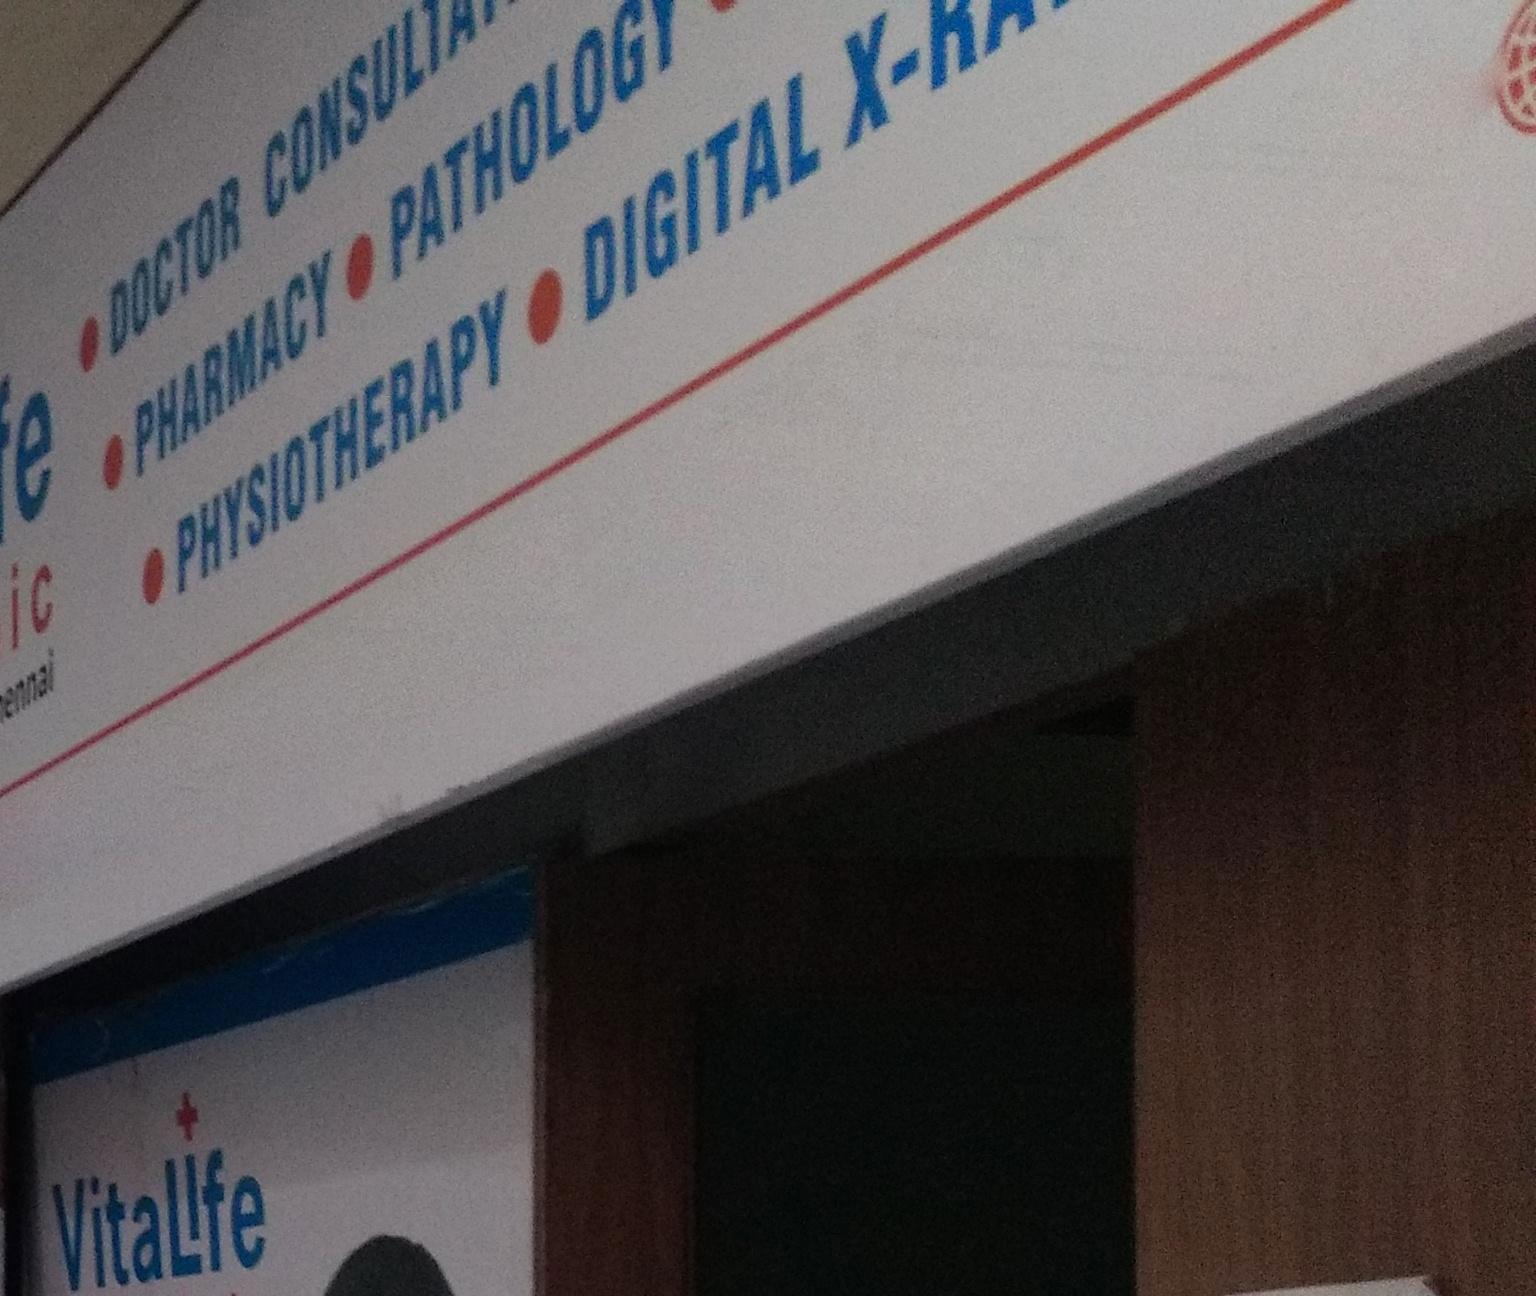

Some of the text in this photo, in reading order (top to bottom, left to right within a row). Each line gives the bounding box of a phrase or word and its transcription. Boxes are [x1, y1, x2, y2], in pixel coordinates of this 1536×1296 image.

[110, 0, 515, 355] DOCTOR CONSULTA
[135, 0, 676, 477] PHARMACY PATHOLOGY
[176, 288, 507, 594] PHYSIOTHERAPY
[584, 73, 820, 323] DIGITAL
[53, 1149, 266, 1291] VitaLife
